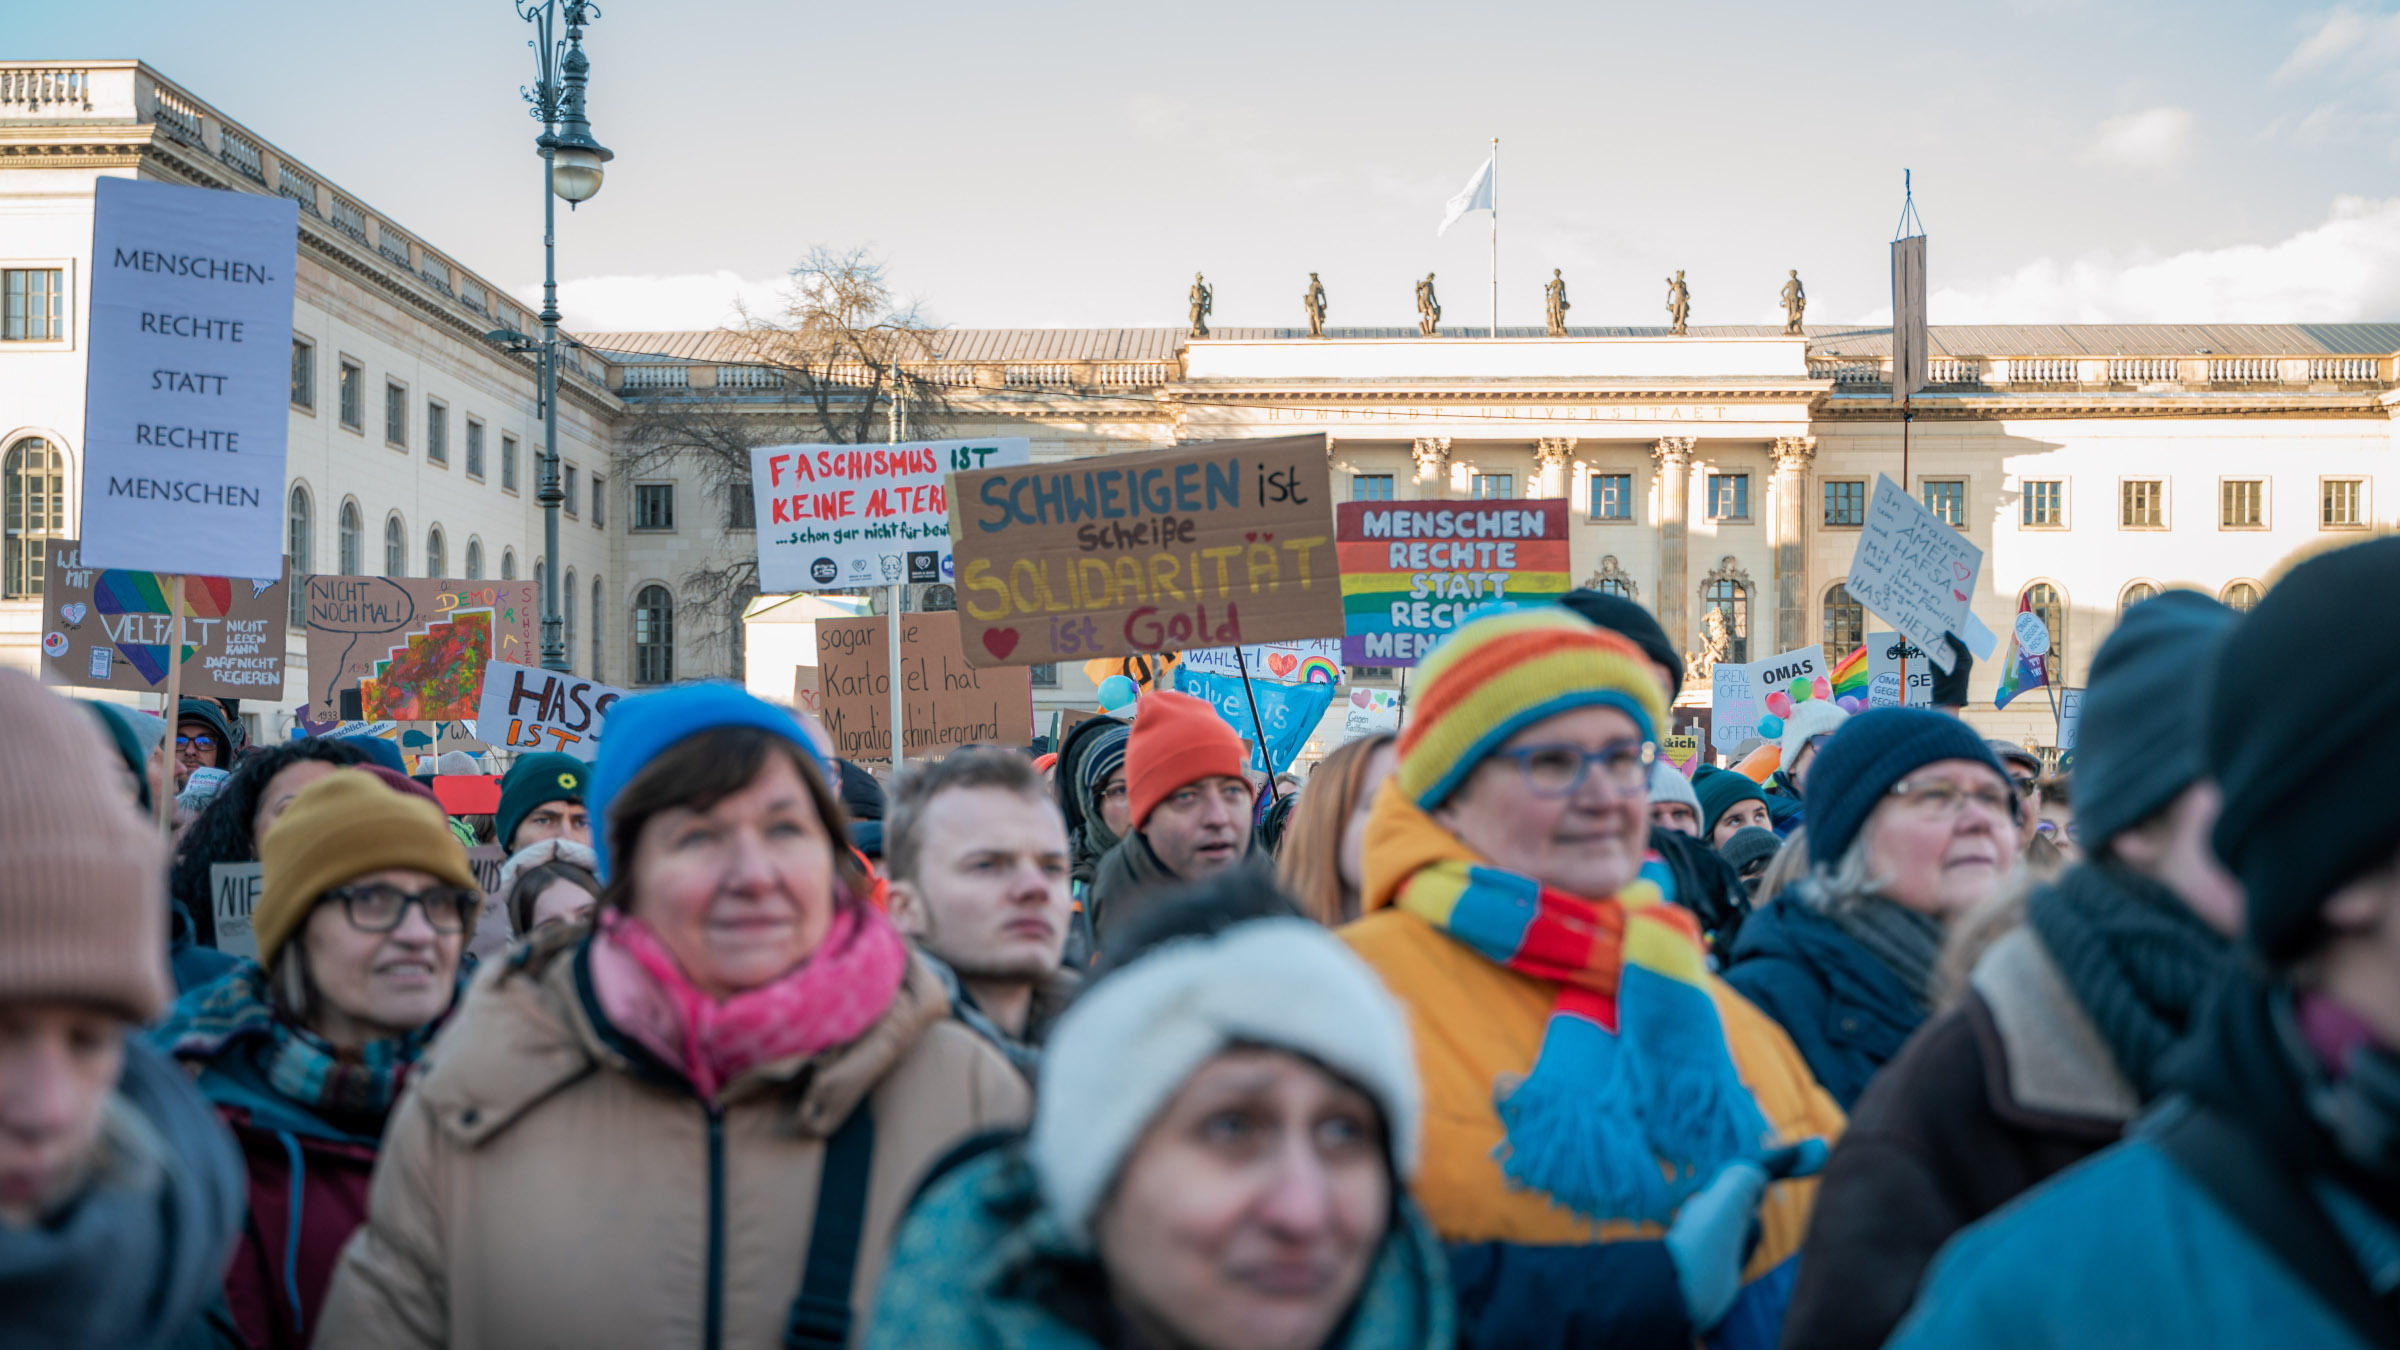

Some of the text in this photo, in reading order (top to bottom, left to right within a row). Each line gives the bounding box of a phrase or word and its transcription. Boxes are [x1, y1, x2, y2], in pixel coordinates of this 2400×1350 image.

[113, 247, 275, 285] MENSCHEN-
[140, 311, 245, 342] RECHTE
[152, 369, 229, 396] STATT
[1268, 407, 1726, 421] HUMBOLDT UNIVERSITAET
[136, 424, 240, 453] RECHTE
[769, 446, 999, 488] FASCHISMUS IST
[108, 476, 260, 508] MENSCHEN
[977, 458, 1309, 534] SCHWEIGEN ist
[772, 490, 857, 525] KEINE
[834, 528, 860, 544] gar
[864, 521, 899, 540] nicht
[1362, 509, 1546, 539] MENSCHEN
[1880, 487, 1969, 560] In Trauer
[57, 549, 81, 569] WE
[1388, 541, 1518, 570] RECHTE
[1870, 523, 1953, 595] und HAFSA
[1896, 527, 1950, 572] AMEL
[963, 530, 1328, 622] SOLIDARITÄT
[1863, 557, 1883, 574] und
[1865, 540, 1941, 606] Mit ihnen
[65, 570, 94, 590] MIT
[311, 581, 371, 602] NICHT
[1409, 572, 1511, 600] STATT
[312, 602, 358, 624] NOCH
[362, 600, 402, 624] MAL!
[1390, 601, 1518, 629] RECH
[1851, 576, 1889, 612] HASS
[1900, 612, 1949, 662] HETZE
[226, 620, 268, 634] NICHT
[226, 634, 267, 645] LEBEN
[521, 587, 534, 667] SCHÜTZE
[821, 615, 919, 656] sogar ie
[1049, 602, 1243, 656] ist Gold
[225, 644, 260, 656] KANN
[1364, 632, 1448, 660] MEN
[203, 656, 278, 670] DARF NICHT
[823, 656, 929, 698] Kartofel
[944, 656, 981, 691] hat
[1762, 659, 1814, 685] OMAS
[213, 669, 281, 686] REGIEREN
[1878, 675, 1900, 686] OMA
[508, 670, 620, 742] HASS
[1720, 684, 1754, 700] OFFE
[1871, 696, 1900, 707] RECHT
[1874, 686, 1900, 698] GEGE
[317, 711, 338, 720] 1933
[824, 701, 999, 758] Migratioshintergrund
[1347, 711, 1369, 726] Gegen
[507, 718, 582, 753] IST
